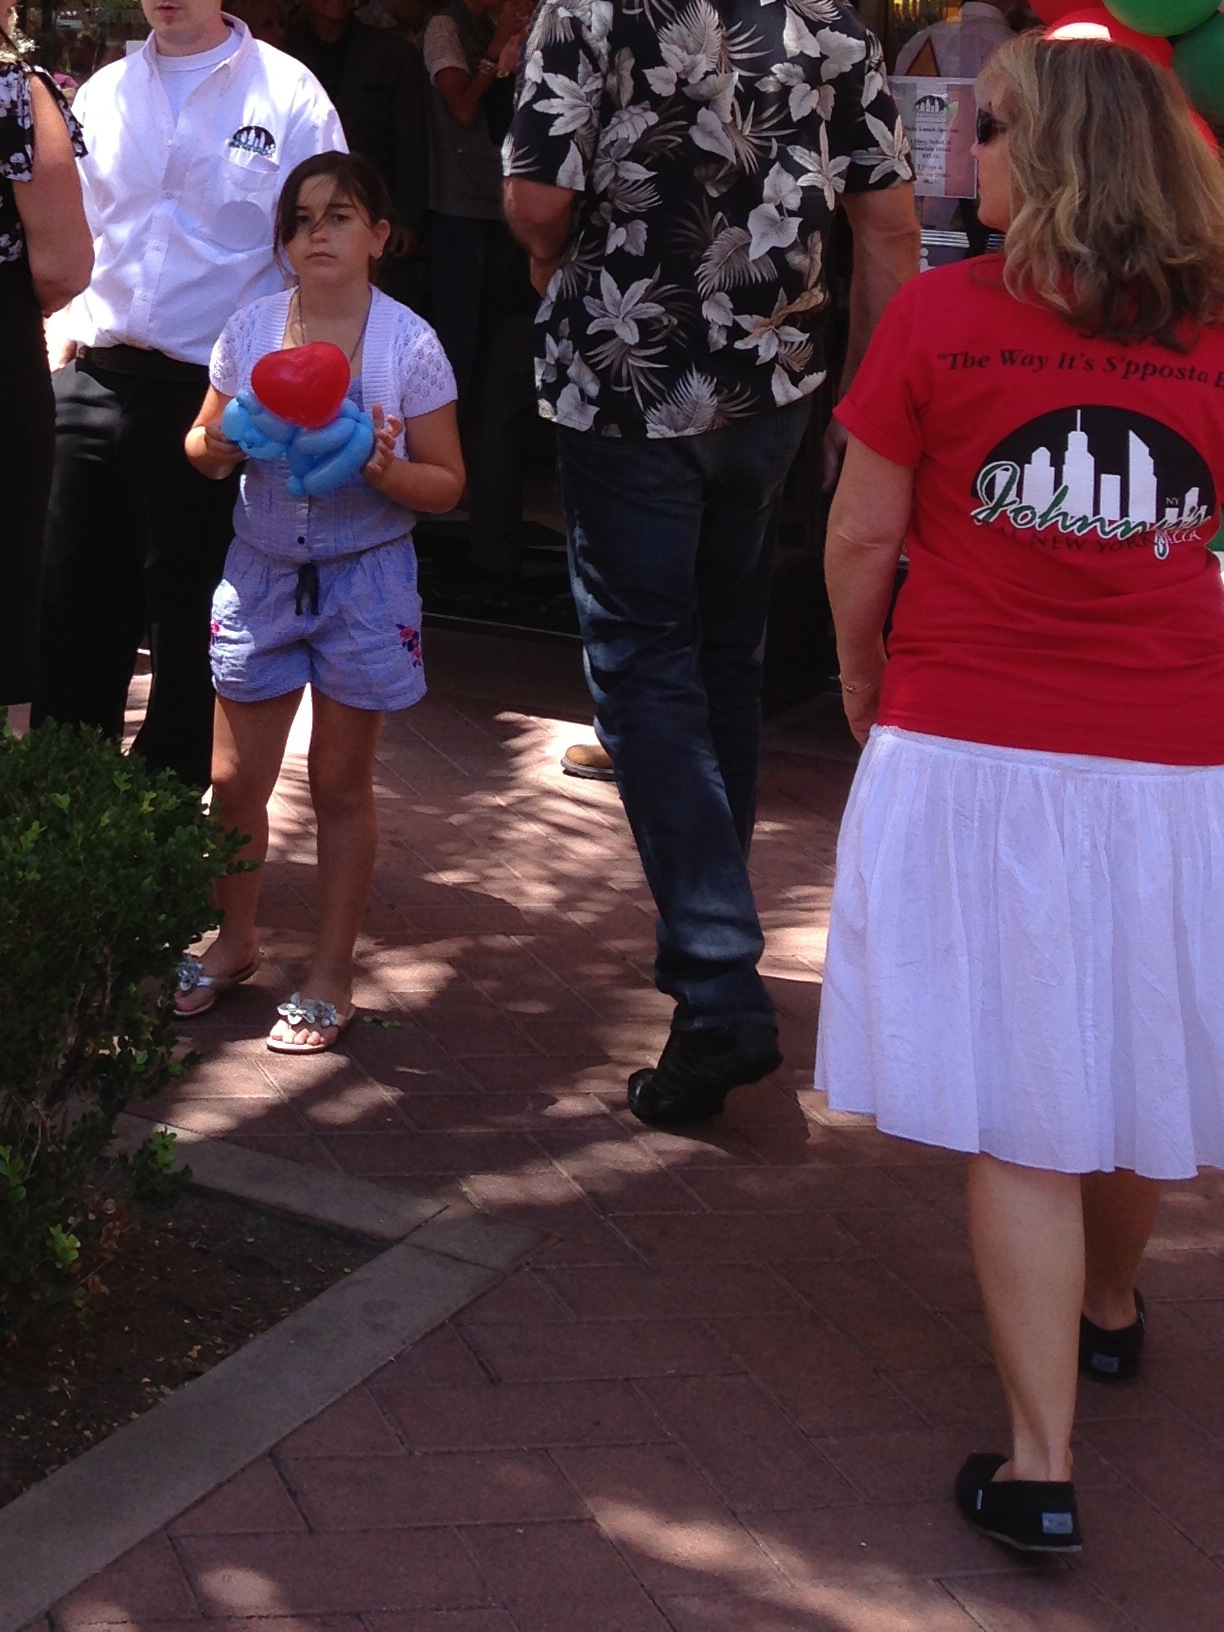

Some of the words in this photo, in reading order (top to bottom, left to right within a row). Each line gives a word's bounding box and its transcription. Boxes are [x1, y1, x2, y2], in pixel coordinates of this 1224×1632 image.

[999, 349, 1049, 373] Way
[1057, 351, 1095, 372] It's
[1103, 355, 1208, 384] S'pposta
[970, 460, 1212, 559] Johnny's
